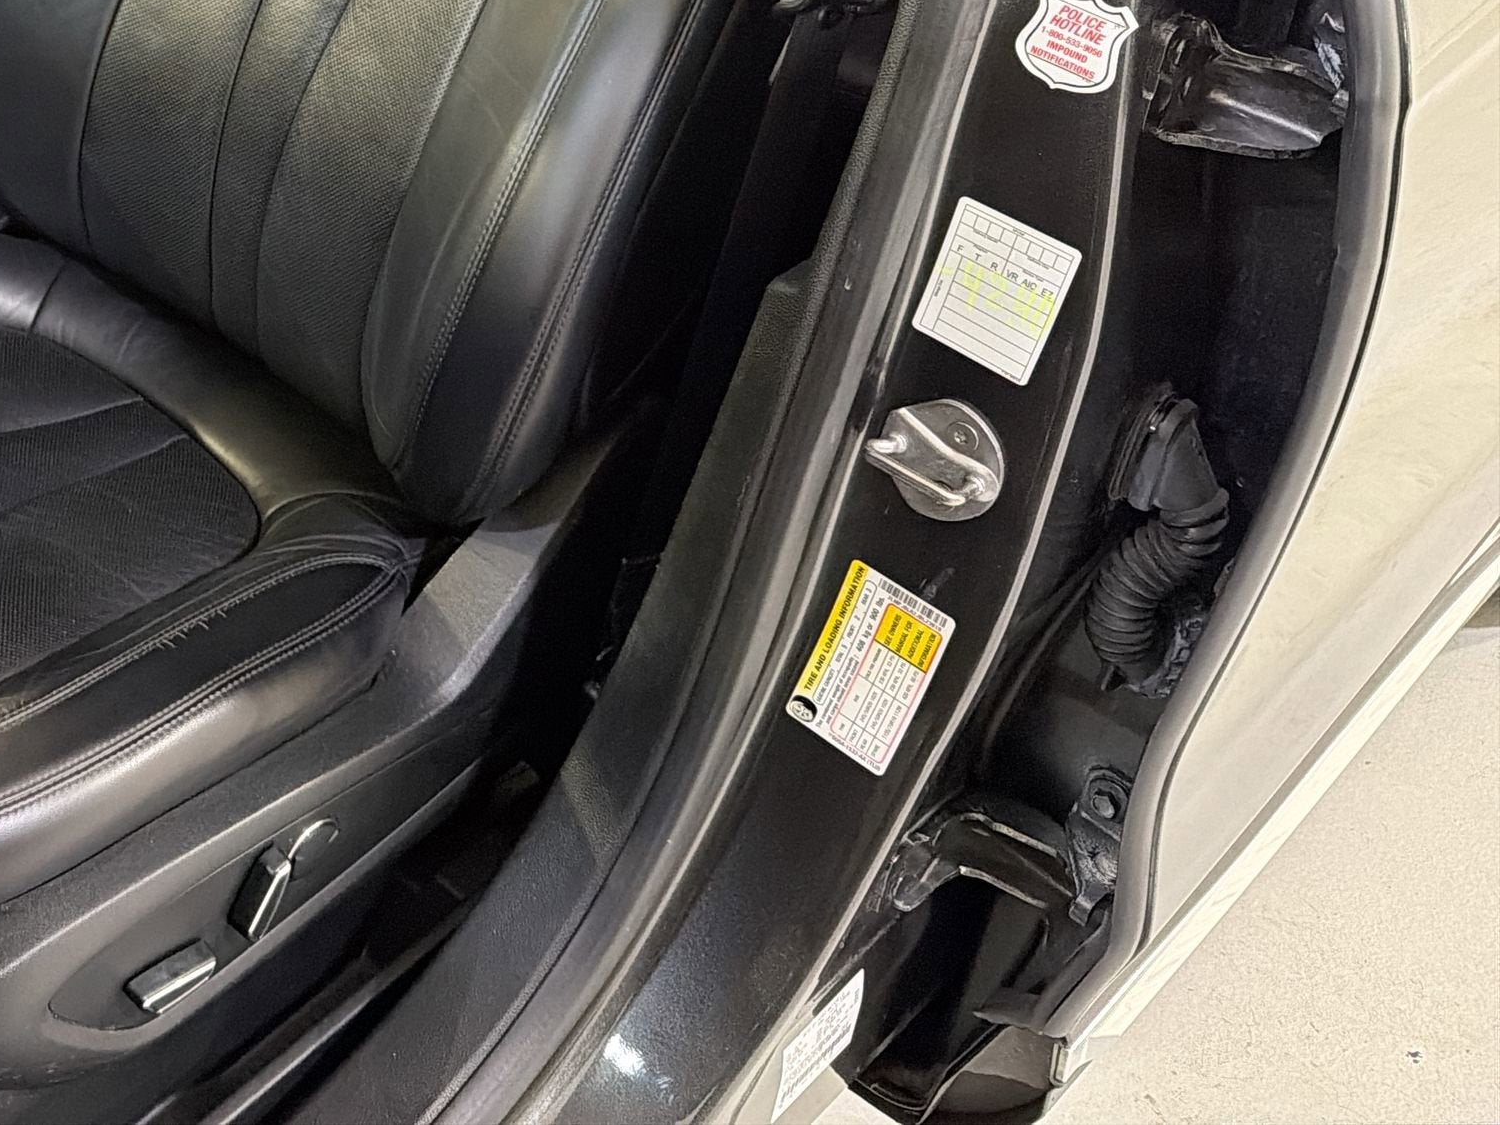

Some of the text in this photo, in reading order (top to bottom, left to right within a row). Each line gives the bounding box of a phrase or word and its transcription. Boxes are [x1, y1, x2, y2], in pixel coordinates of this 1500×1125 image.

[1049, 14, 1106, 45] HOTLINE
[1058, 4, 1107, 33] POLICE
[1030, 45, 1094, 79] NOTIFICATIONS
[1046, 40, 1088, 63] IMPOUND
[956, 244, 965, 252] F
[975, 252, 982, 261] T
[989, 261, 999, 272] R
[1006, 269, 1019, 282] VR
[866, 622, 874, 631] or
[869, 607, 880, 621] 900
[888, 614, 902, 636] OWNERS
[903, 620, 913, 633] FOR
[803, 565, 866, 691] TIRE AND LOADING INFORMATION
[861, 629, 872, 639] kg
[906, 629, 925, 660] ADDITIONAL
